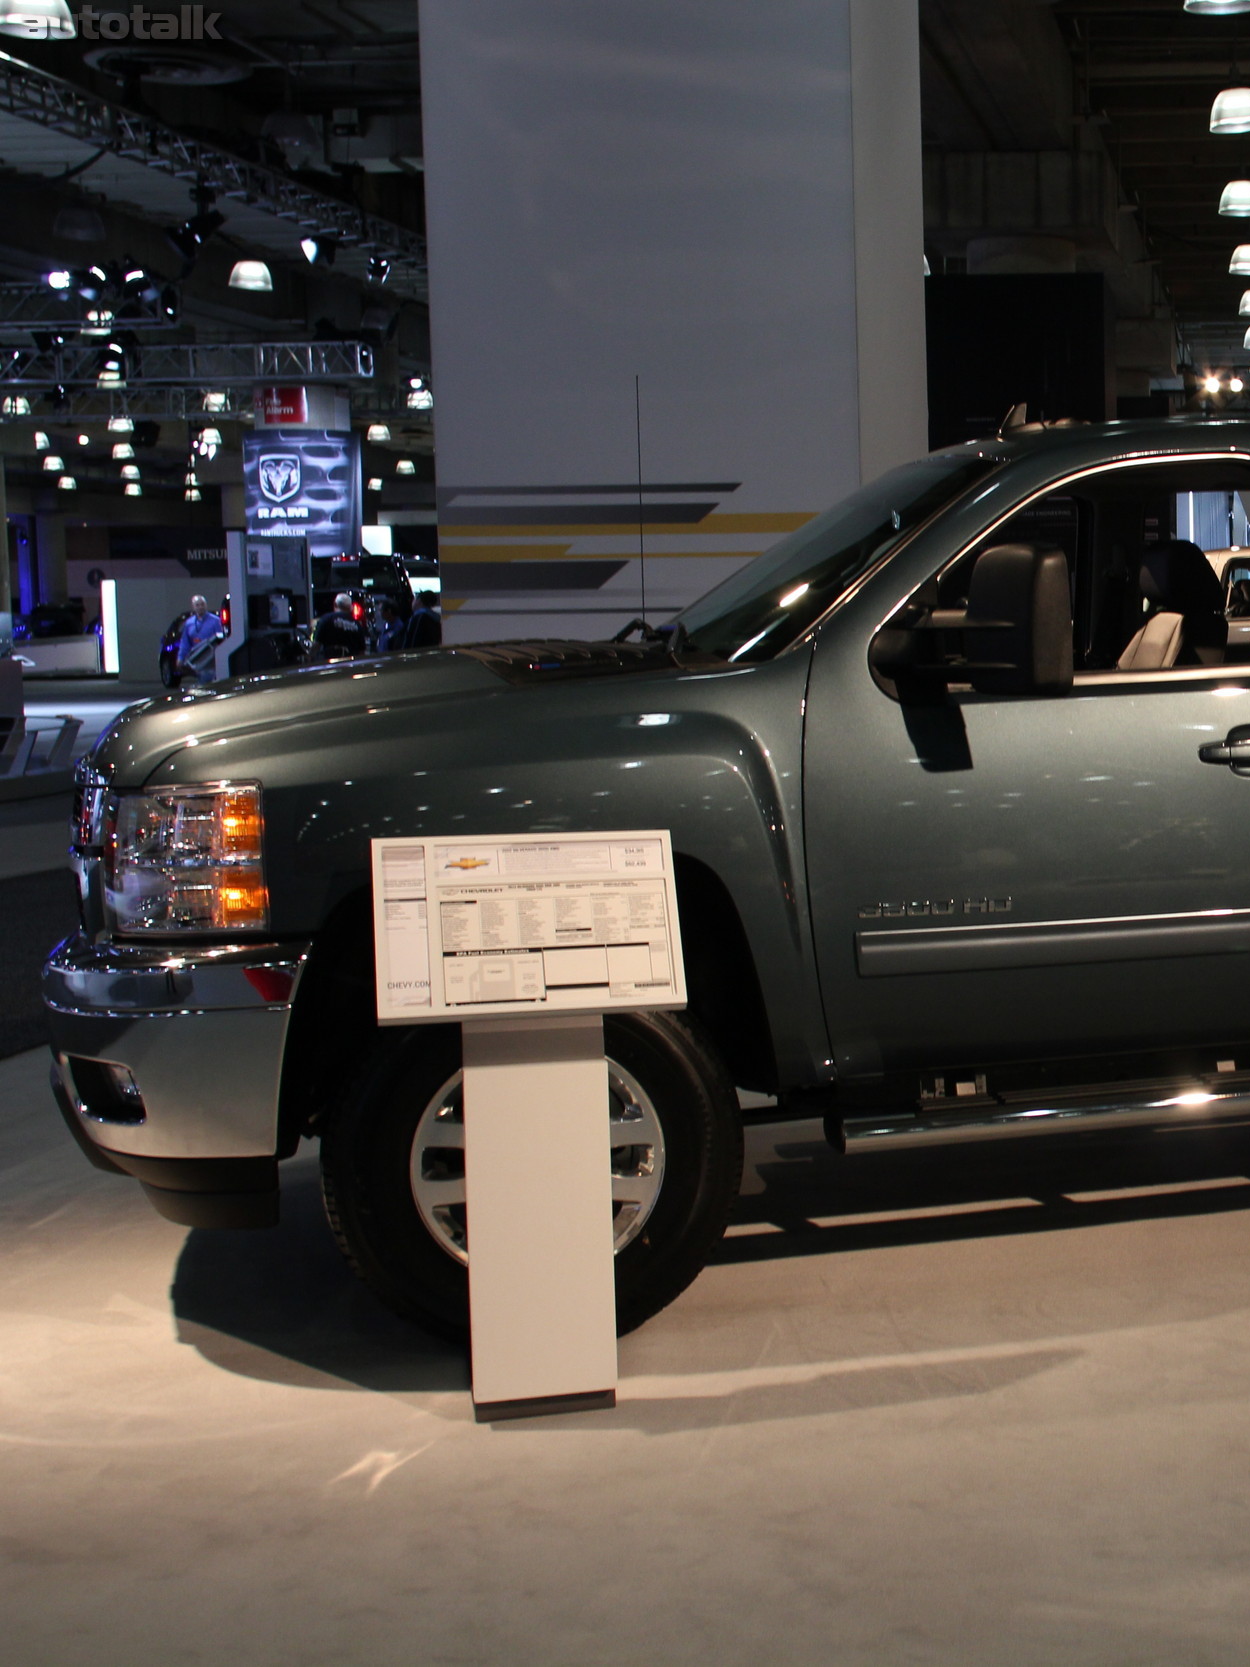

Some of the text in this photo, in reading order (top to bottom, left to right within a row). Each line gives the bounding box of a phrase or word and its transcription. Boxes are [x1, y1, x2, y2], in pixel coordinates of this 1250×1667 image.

[258, 507, 309, 519] RAM
[186, 548, 227, 561] MITSU
[963, 896, 1013, 914] HD
